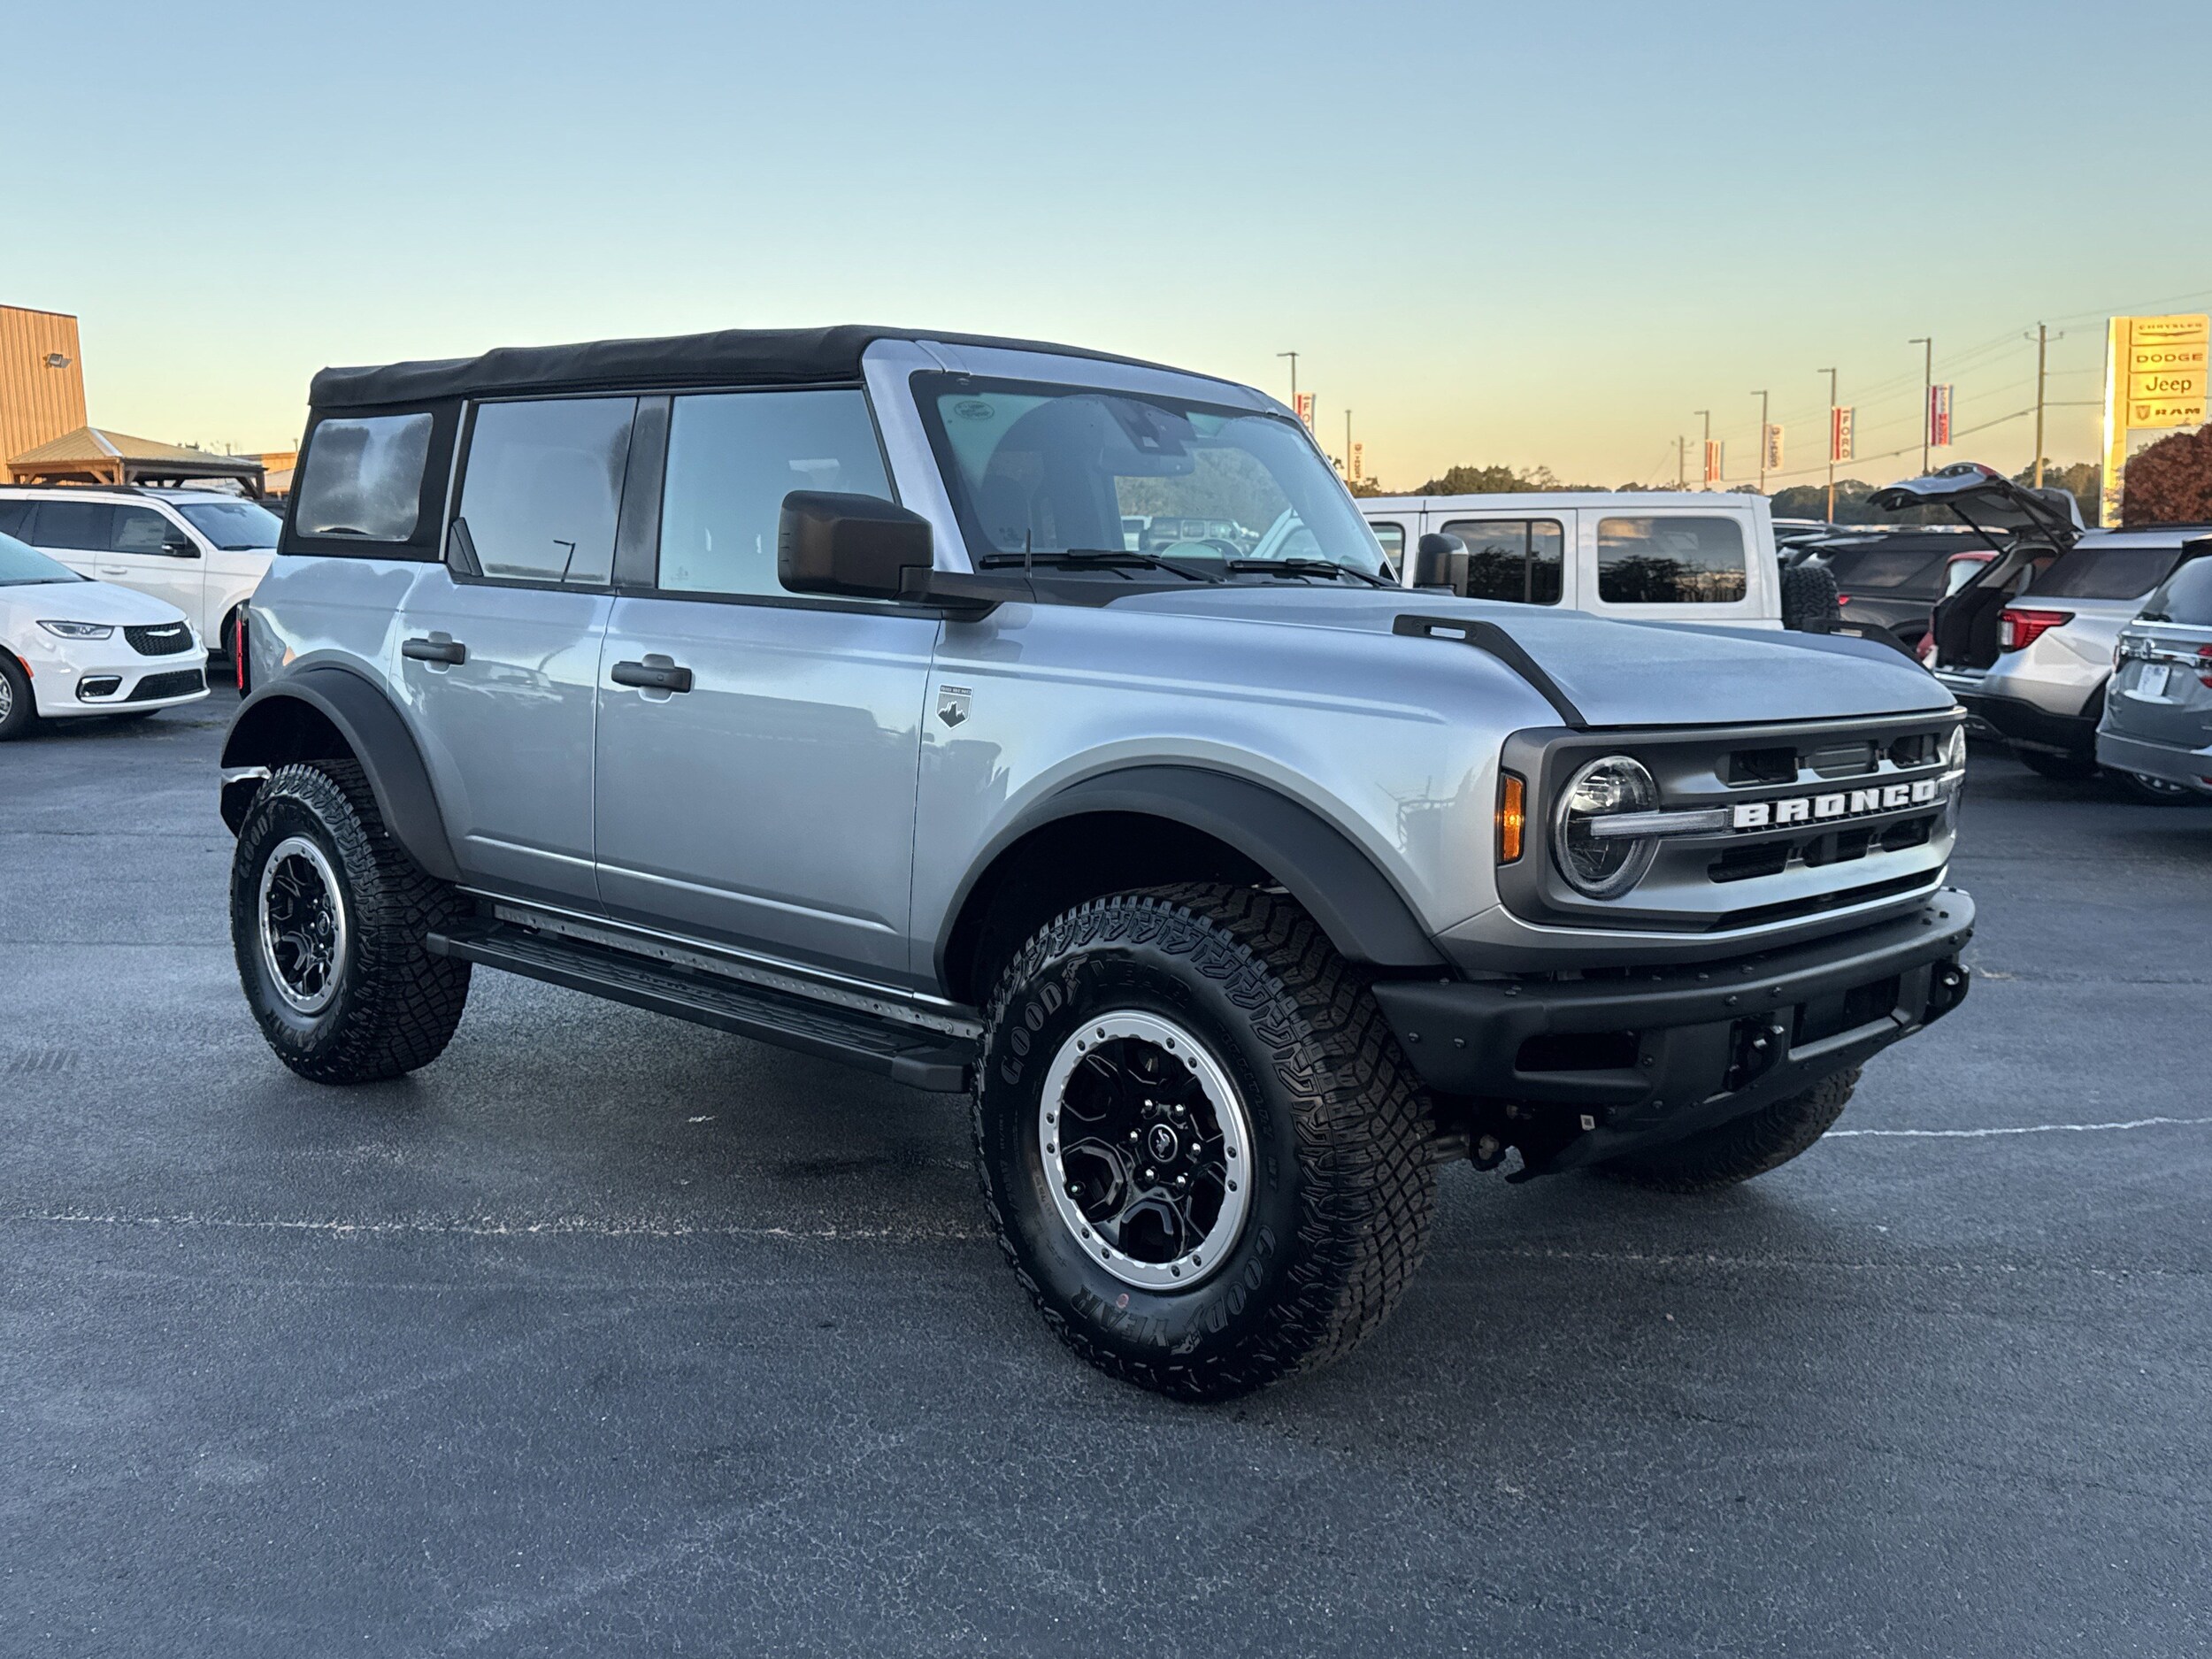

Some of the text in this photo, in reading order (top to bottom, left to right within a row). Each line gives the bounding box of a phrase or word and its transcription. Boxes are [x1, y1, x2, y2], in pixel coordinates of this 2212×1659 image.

[2137, 353, 2203, 363] DODGE
[2146, 376, 2192, 394] Jeep
[1841, 416, 1850, 458] FORD
[1733, 780, 1936, 828] BRONCO
